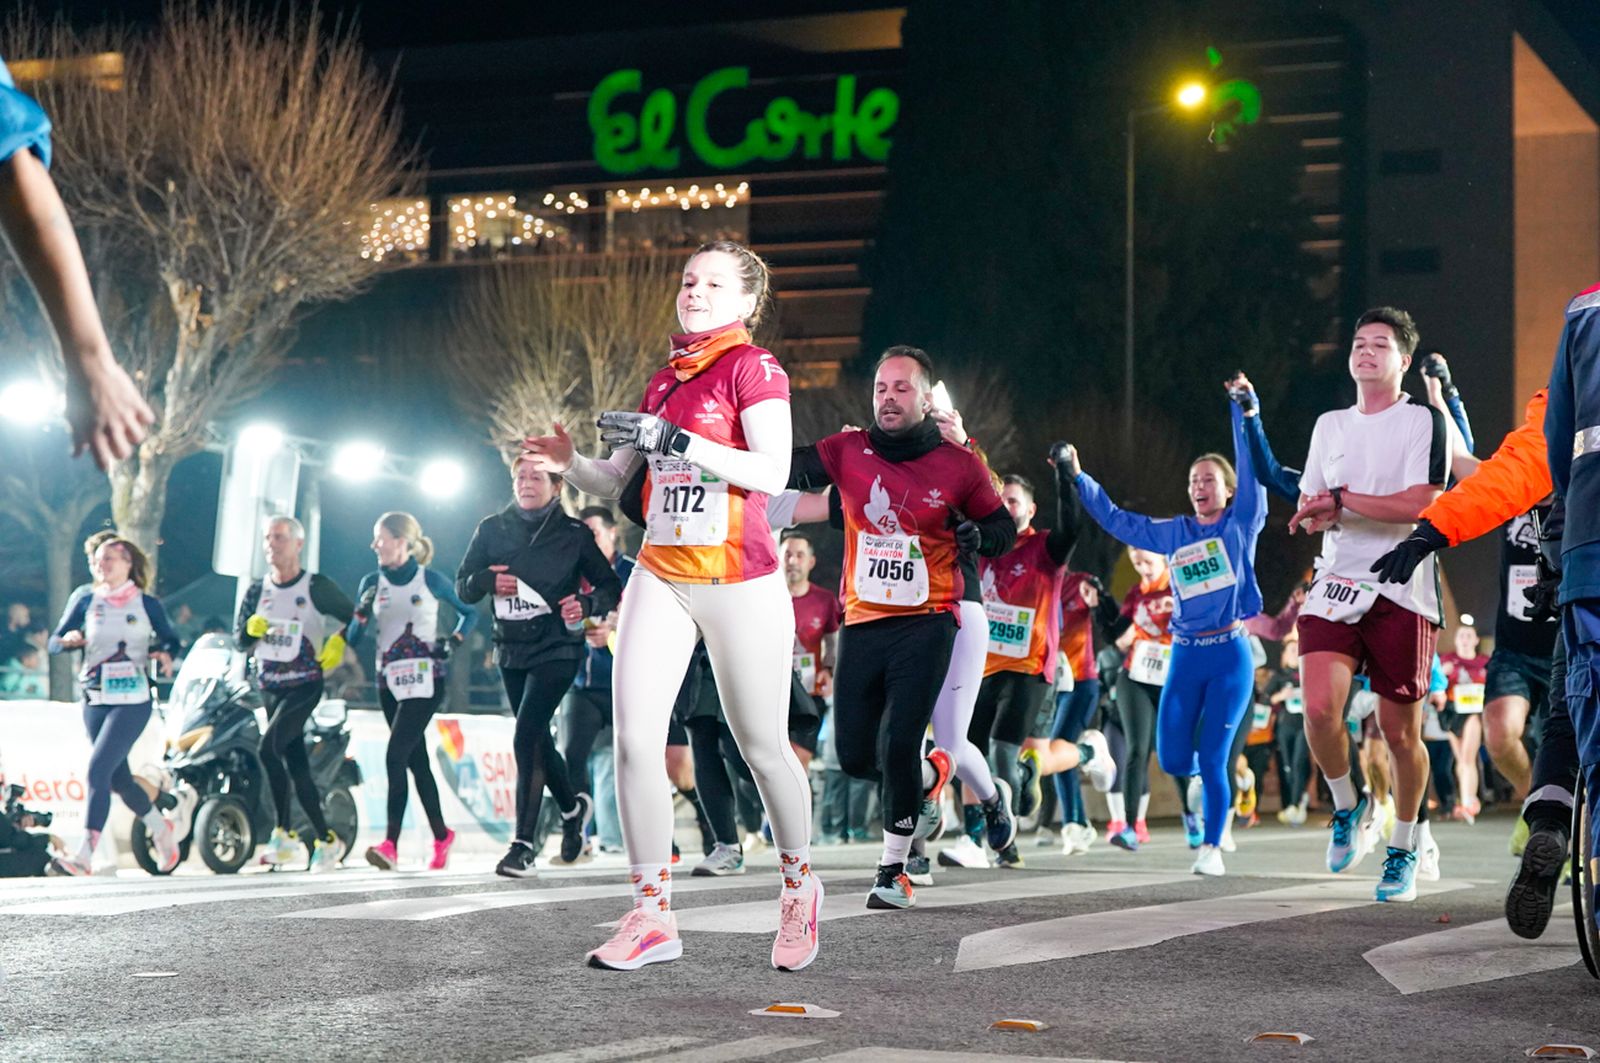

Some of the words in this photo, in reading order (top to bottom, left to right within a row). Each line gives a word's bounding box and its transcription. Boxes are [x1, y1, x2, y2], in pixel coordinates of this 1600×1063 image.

[588, 68, 681, 174] El
[686, 66, 899, 169] Corte
[663, 485, 706, 513] 2172
[877, 514, 897, 535] 43
[868, 557, 914, 582] 7056
[1182, 556, 1220, 581] 9439
[1323, 582, 1361, 605] 1001
[989, 621, 1025, 641] 2958
[1193, 634, 1228, 647] NIKE
